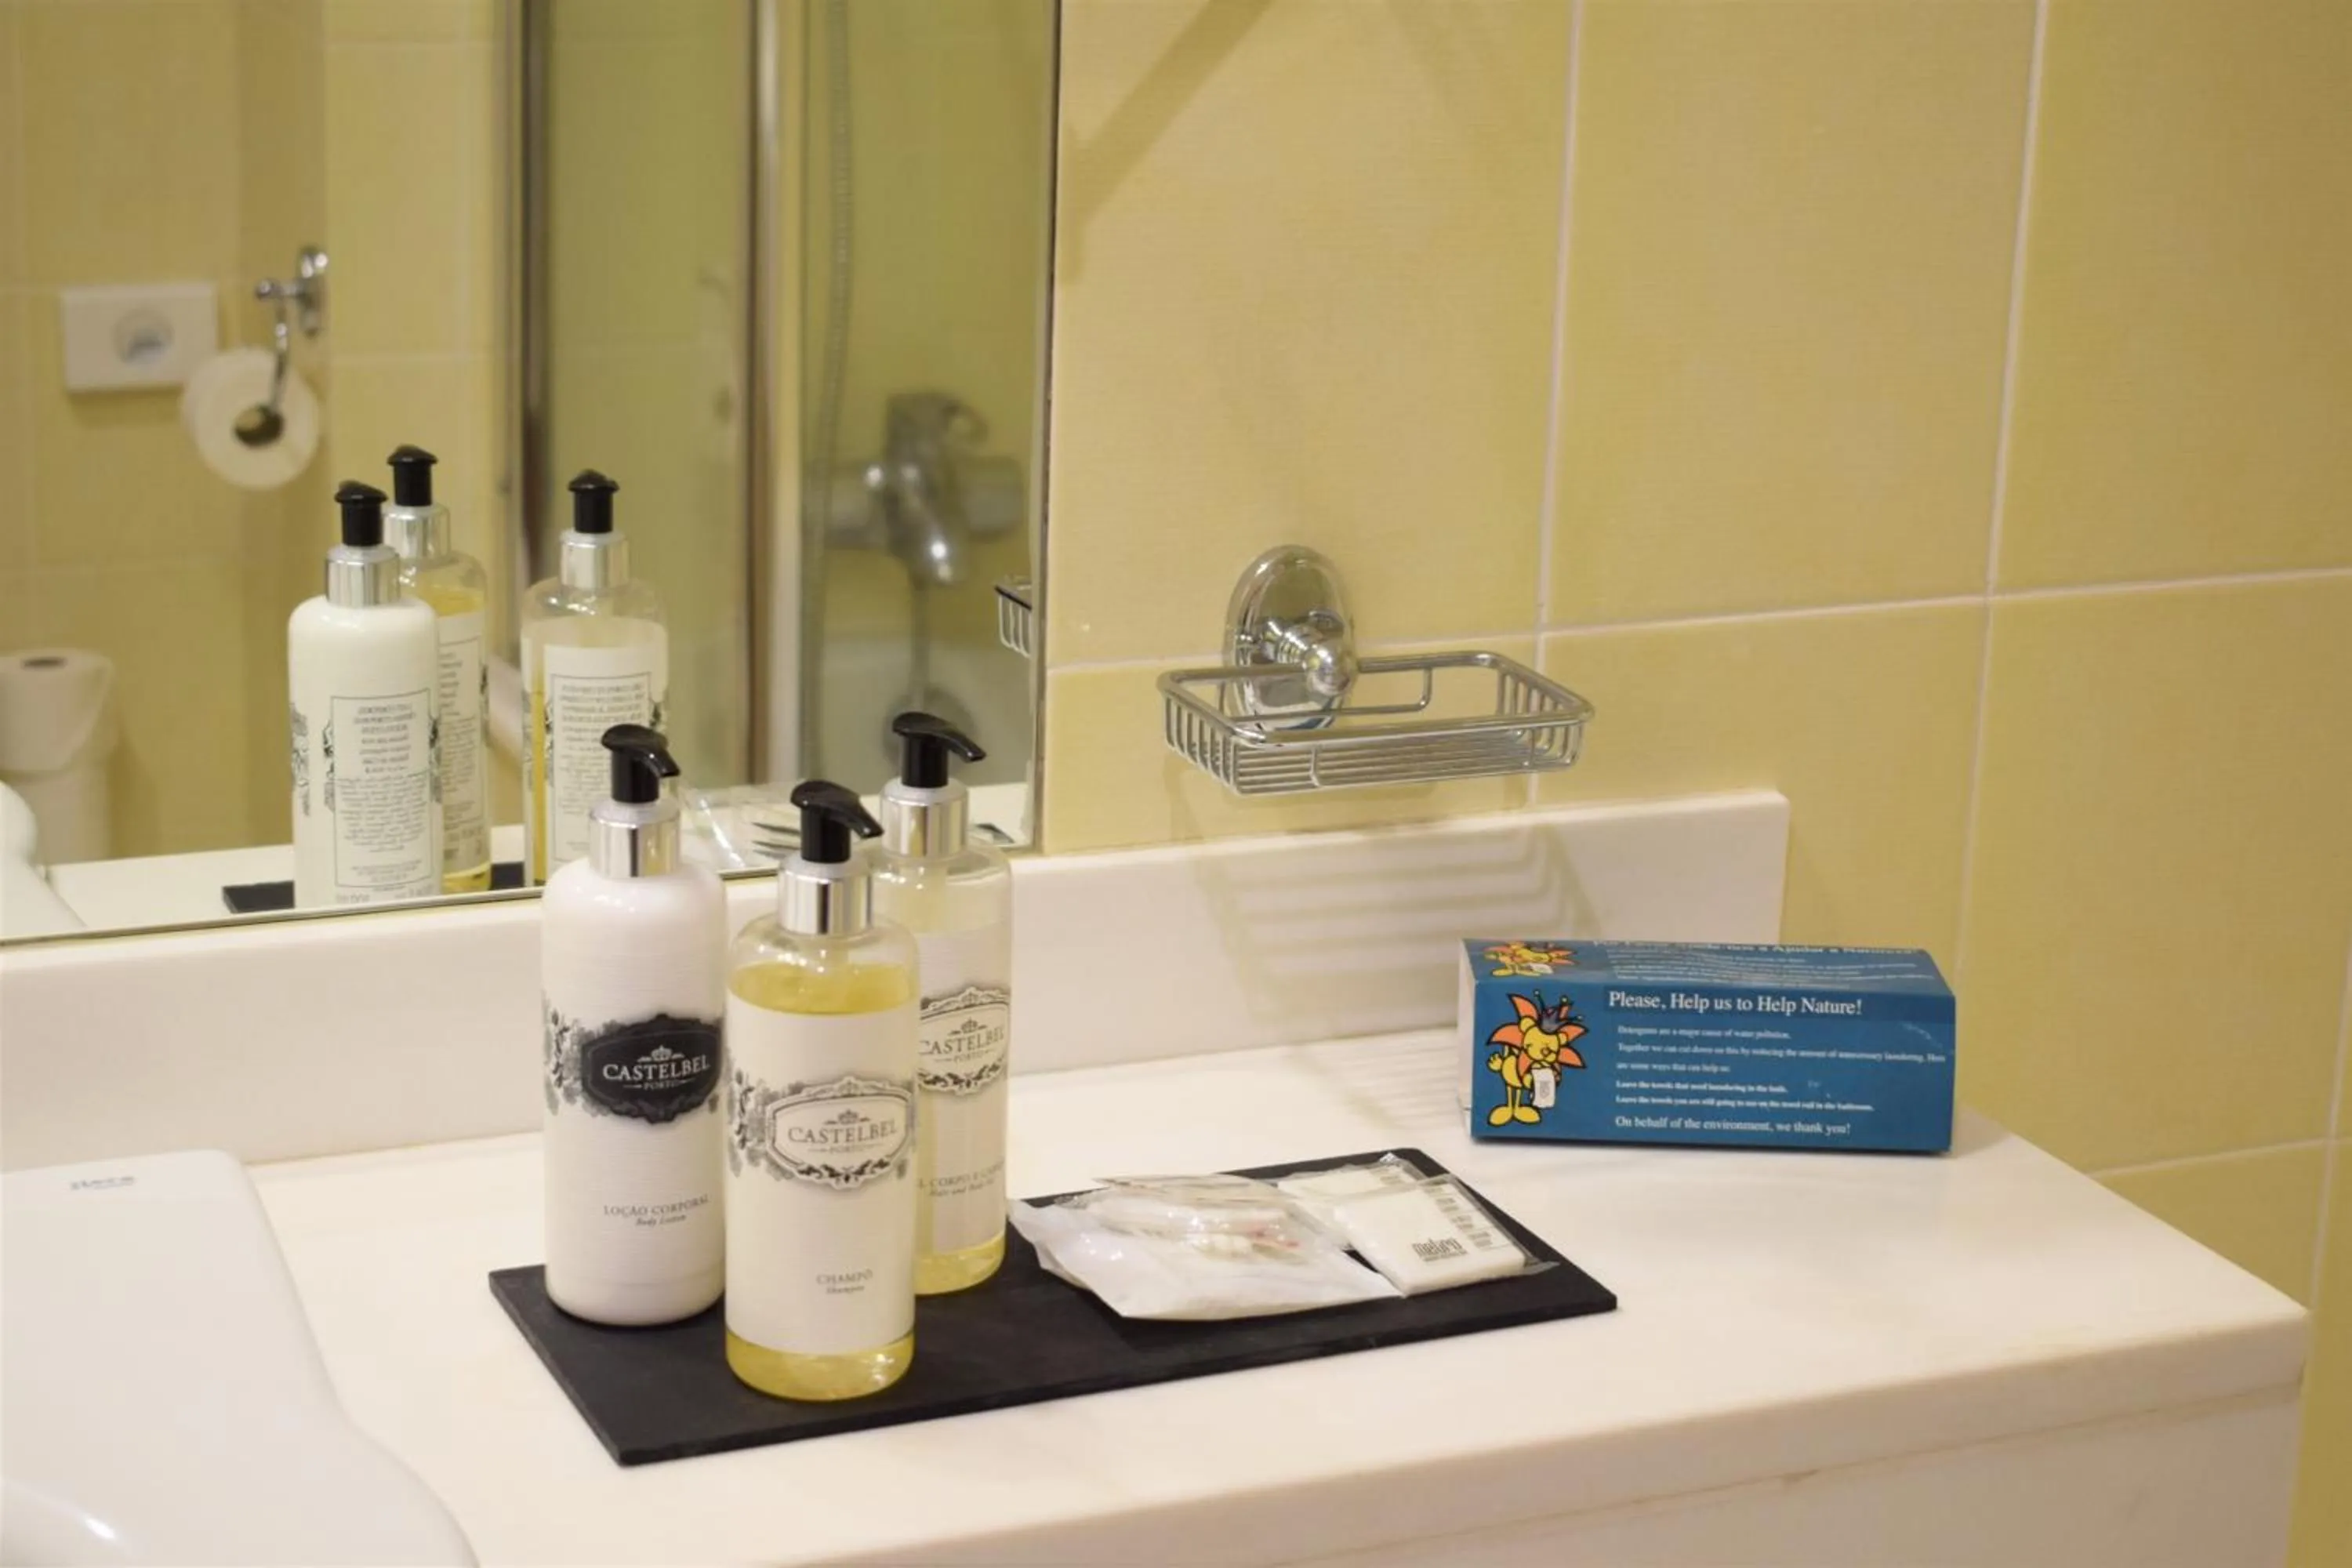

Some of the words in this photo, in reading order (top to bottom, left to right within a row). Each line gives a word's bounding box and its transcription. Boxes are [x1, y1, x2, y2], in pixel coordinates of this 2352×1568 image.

[1609, 991, 1667, 1011] Please,
[1670, 992, 1710, 1014] Help
[1714, 998, 1733, 1011] us
[1737, 996, 1753, 1011] to
[1757, 995, 1797, 1017] Help
[1800, 996, 1863, 1015] Nature!
[602, 1054, 711, 1080] CASTELBEL
[788, 1118, 897, 1144] CASTELBEL
[1615, 1115, 1632, 1127] On
[1634, 1116, 1668, 1129] behalf
[1670, 1117, 1682, 1129] of
[1684, 1118, 1701, 1130] the
[1703, 1120, 1774, 1131] environment,
[1775, 1123, 1791, 1132] we
[1793, 1122, 1824, 1133] thank
[1824, 1122, 1851, 1137] you!
[651, 1192, 710, 1214] CORPORAL
[636, 1218, 658, 1229] Body
